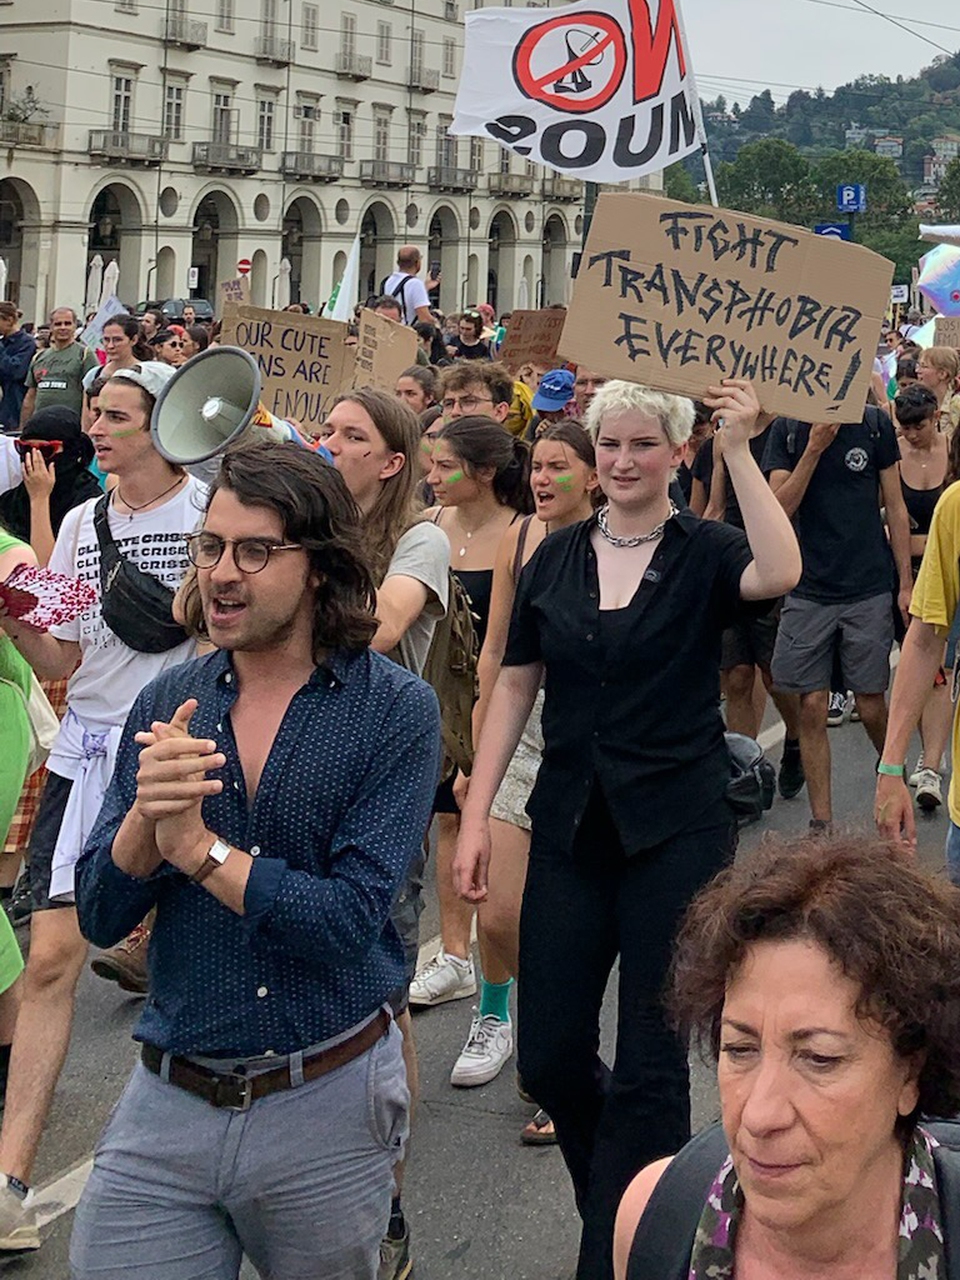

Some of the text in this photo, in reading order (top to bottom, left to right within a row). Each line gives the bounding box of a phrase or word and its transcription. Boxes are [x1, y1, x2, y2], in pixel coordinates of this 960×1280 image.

[659, 211, 799, 273] FIGHT
[587, 250, 863, 352] TRANSPHOBIA
[236, 321, 274, 349] OUR
[281, 328, 331, 359] CUTE
[291, 359, 331, 385] ARE
